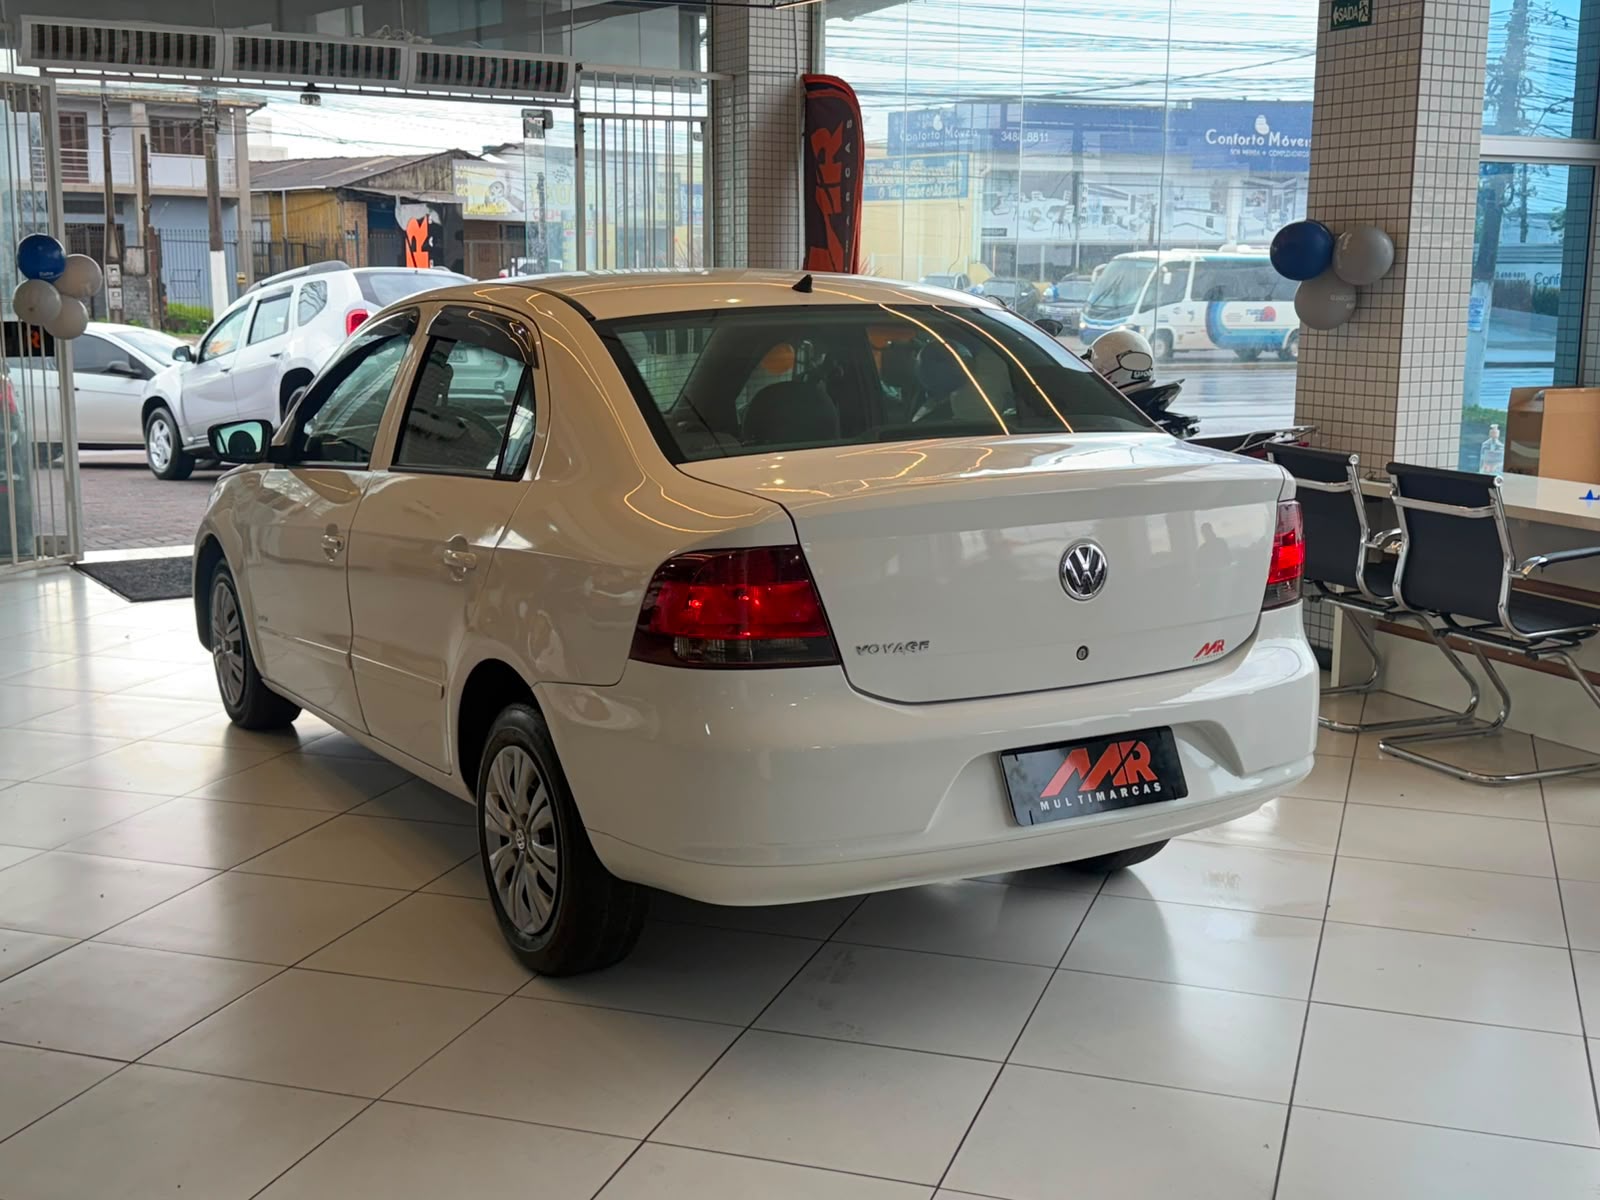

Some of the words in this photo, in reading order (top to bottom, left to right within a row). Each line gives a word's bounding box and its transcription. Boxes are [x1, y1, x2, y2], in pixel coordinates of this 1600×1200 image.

[1205, 128, 1265, 146] Conforto
[856, 640, 930, 656] VOYAGE
[1040, 740, 1158, 798] MR
[1040, 782, 1161, 811] MULTIMARCAS
